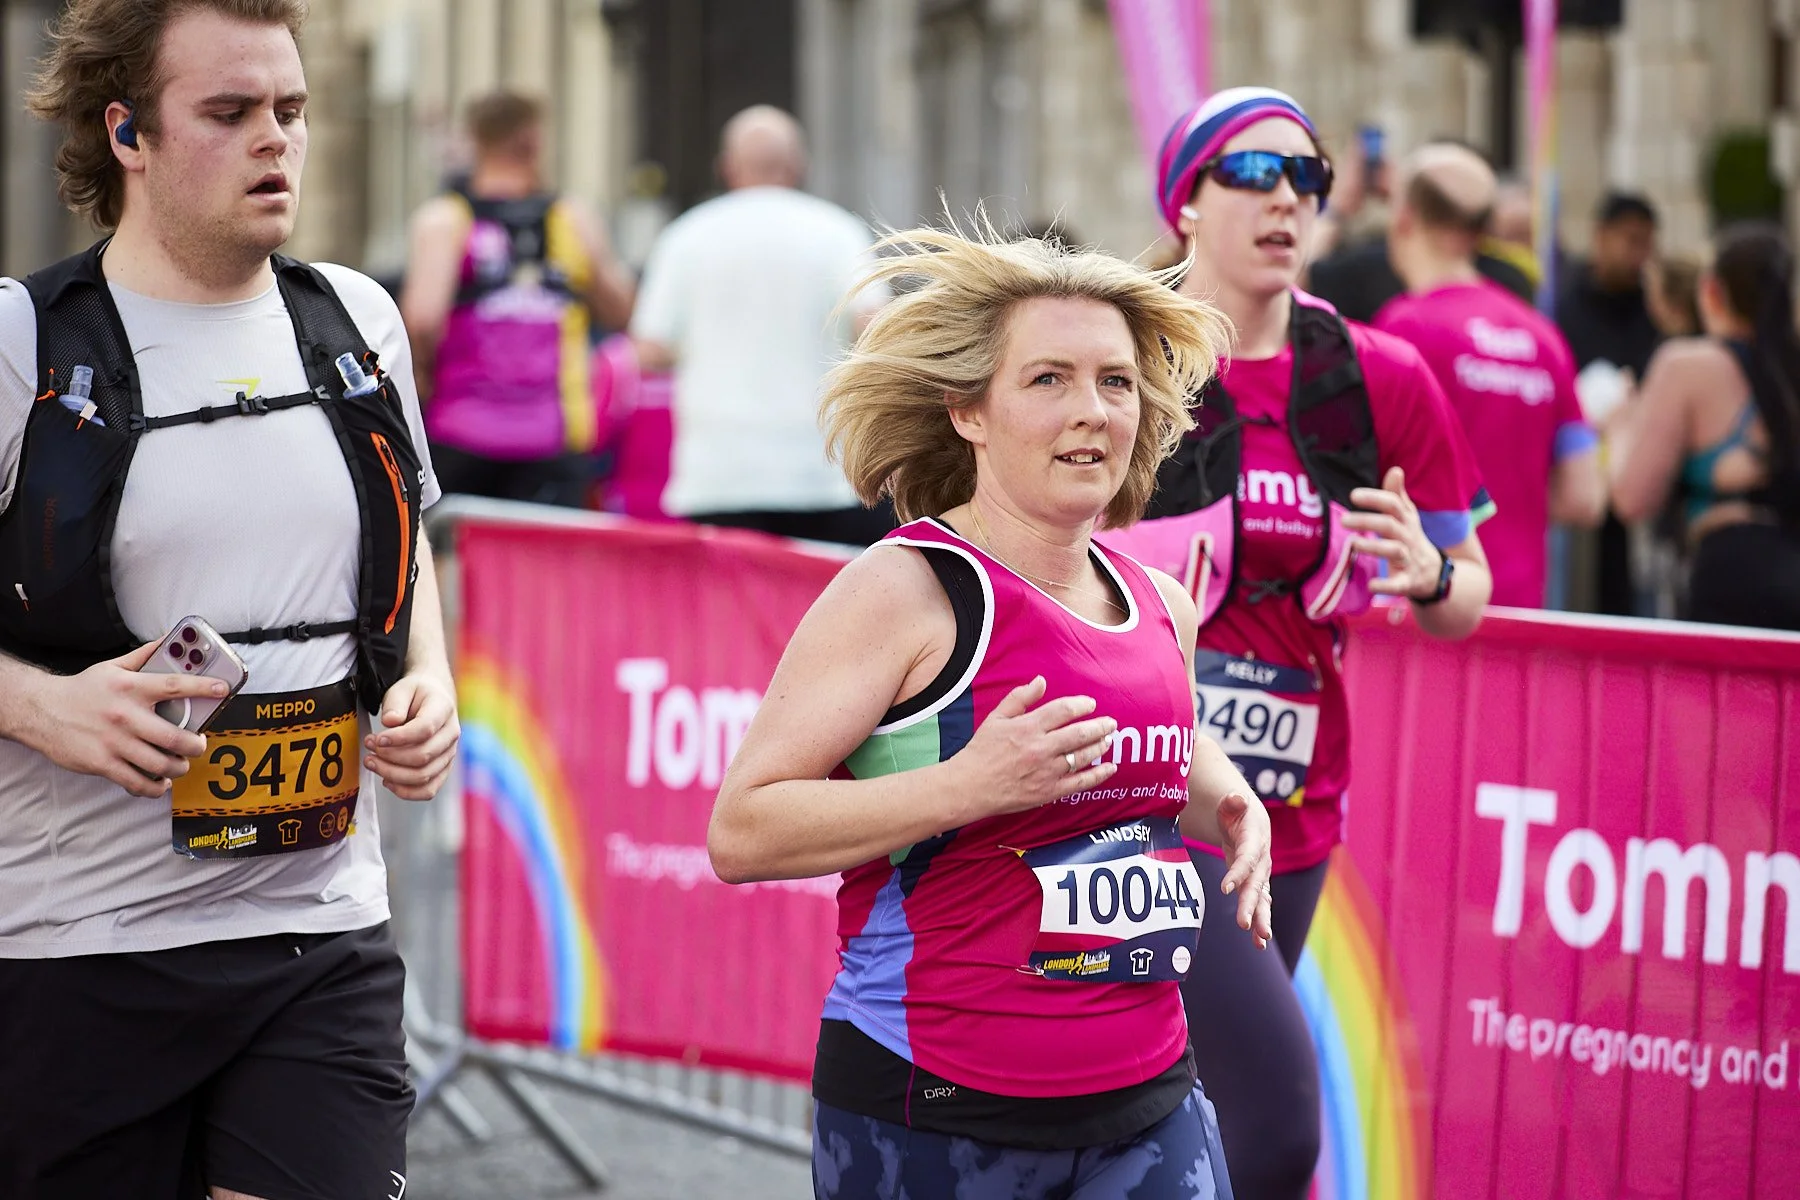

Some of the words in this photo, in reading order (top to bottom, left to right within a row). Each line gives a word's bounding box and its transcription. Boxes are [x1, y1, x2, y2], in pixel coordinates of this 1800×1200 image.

[1238, 469, 1323, 518] my
[1224, 660, 1278, 685] KELLY
[256, 698, 316, 719] MEPPO
[207, 732, 343, 801] 3478
[1131, 782, 1158, 799] and
[189, 834, 220, 848] LONDON
[1089, 824, 1151, 845] LINDSEY
[1056, 865, 1200, 926] 10044
[1043, 958, 1076, 970] LONDON
[1467, 996, 1528, 1051] The
[1529, 1017, 1712, 1088] pregnancy
[1720, 1038, 1789, 1089] and
